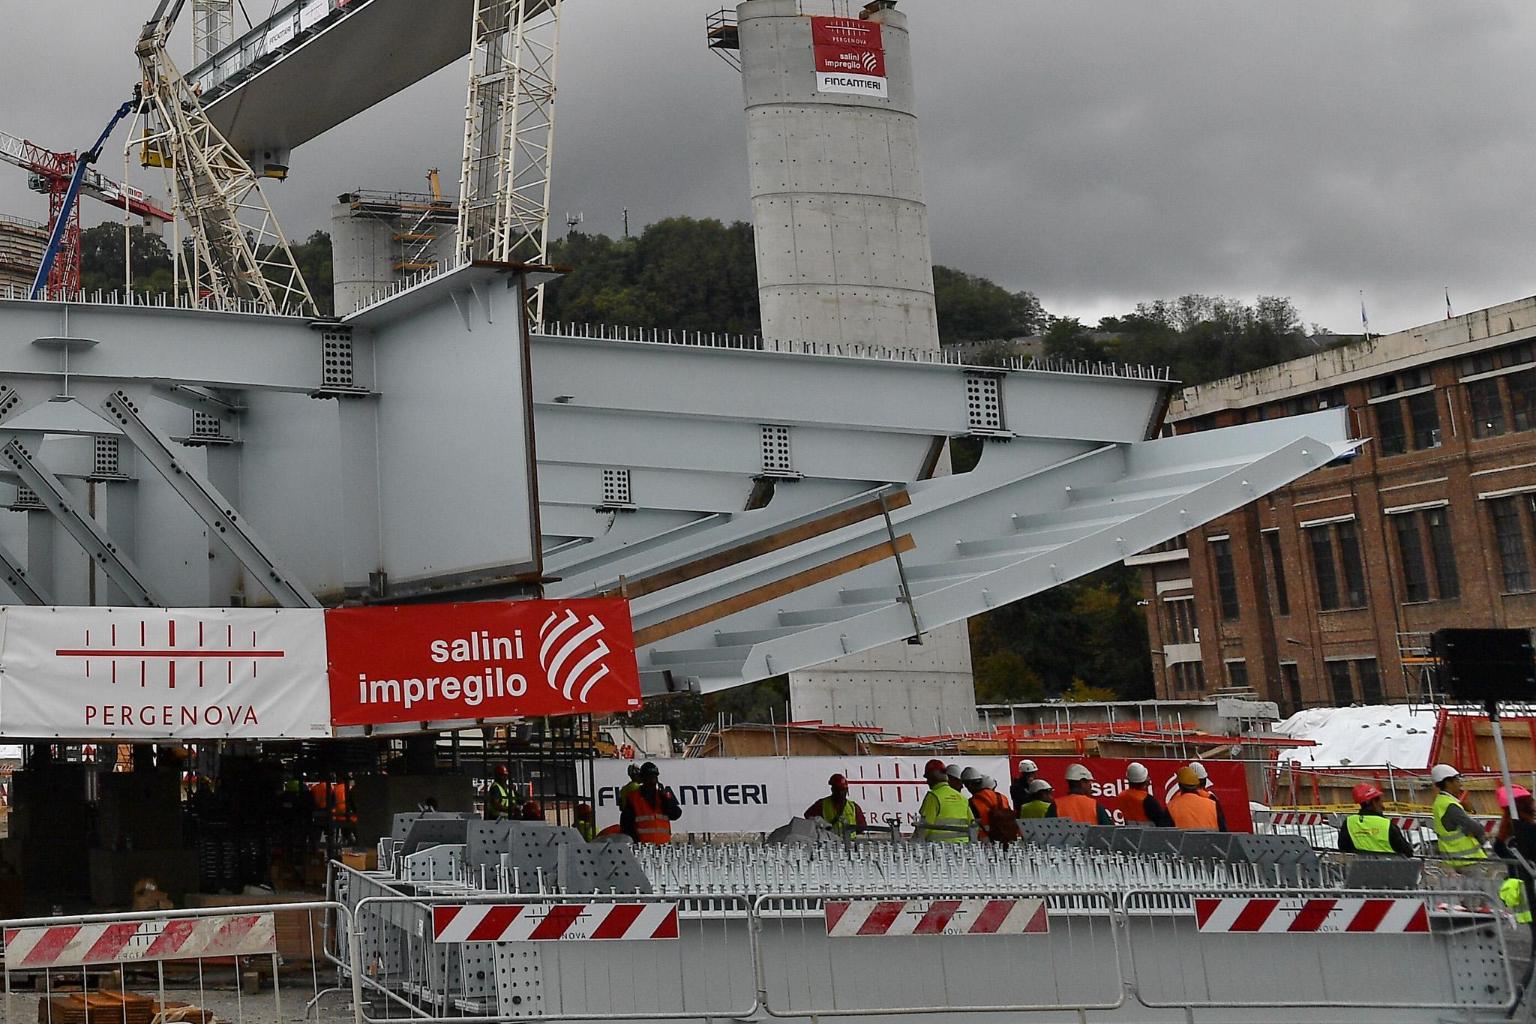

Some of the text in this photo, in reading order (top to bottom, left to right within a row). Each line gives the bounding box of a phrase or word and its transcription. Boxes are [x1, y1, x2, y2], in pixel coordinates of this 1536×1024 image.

[832, 37, 867, 45] PERGENOVA
[825, 60, 861, 69] impregilo
[840, 53, 860, 62] salini
[824, 78, 881, 89] FINCANTIERI
[431, 629, 524, 663] salini
[358, 667, 528, 709] impregilo
[85, 705, 259, 726] PERGENOVA
[598, 784, 768, 807] FIANTIERI
[1090, 778, 1154, 797] salii
